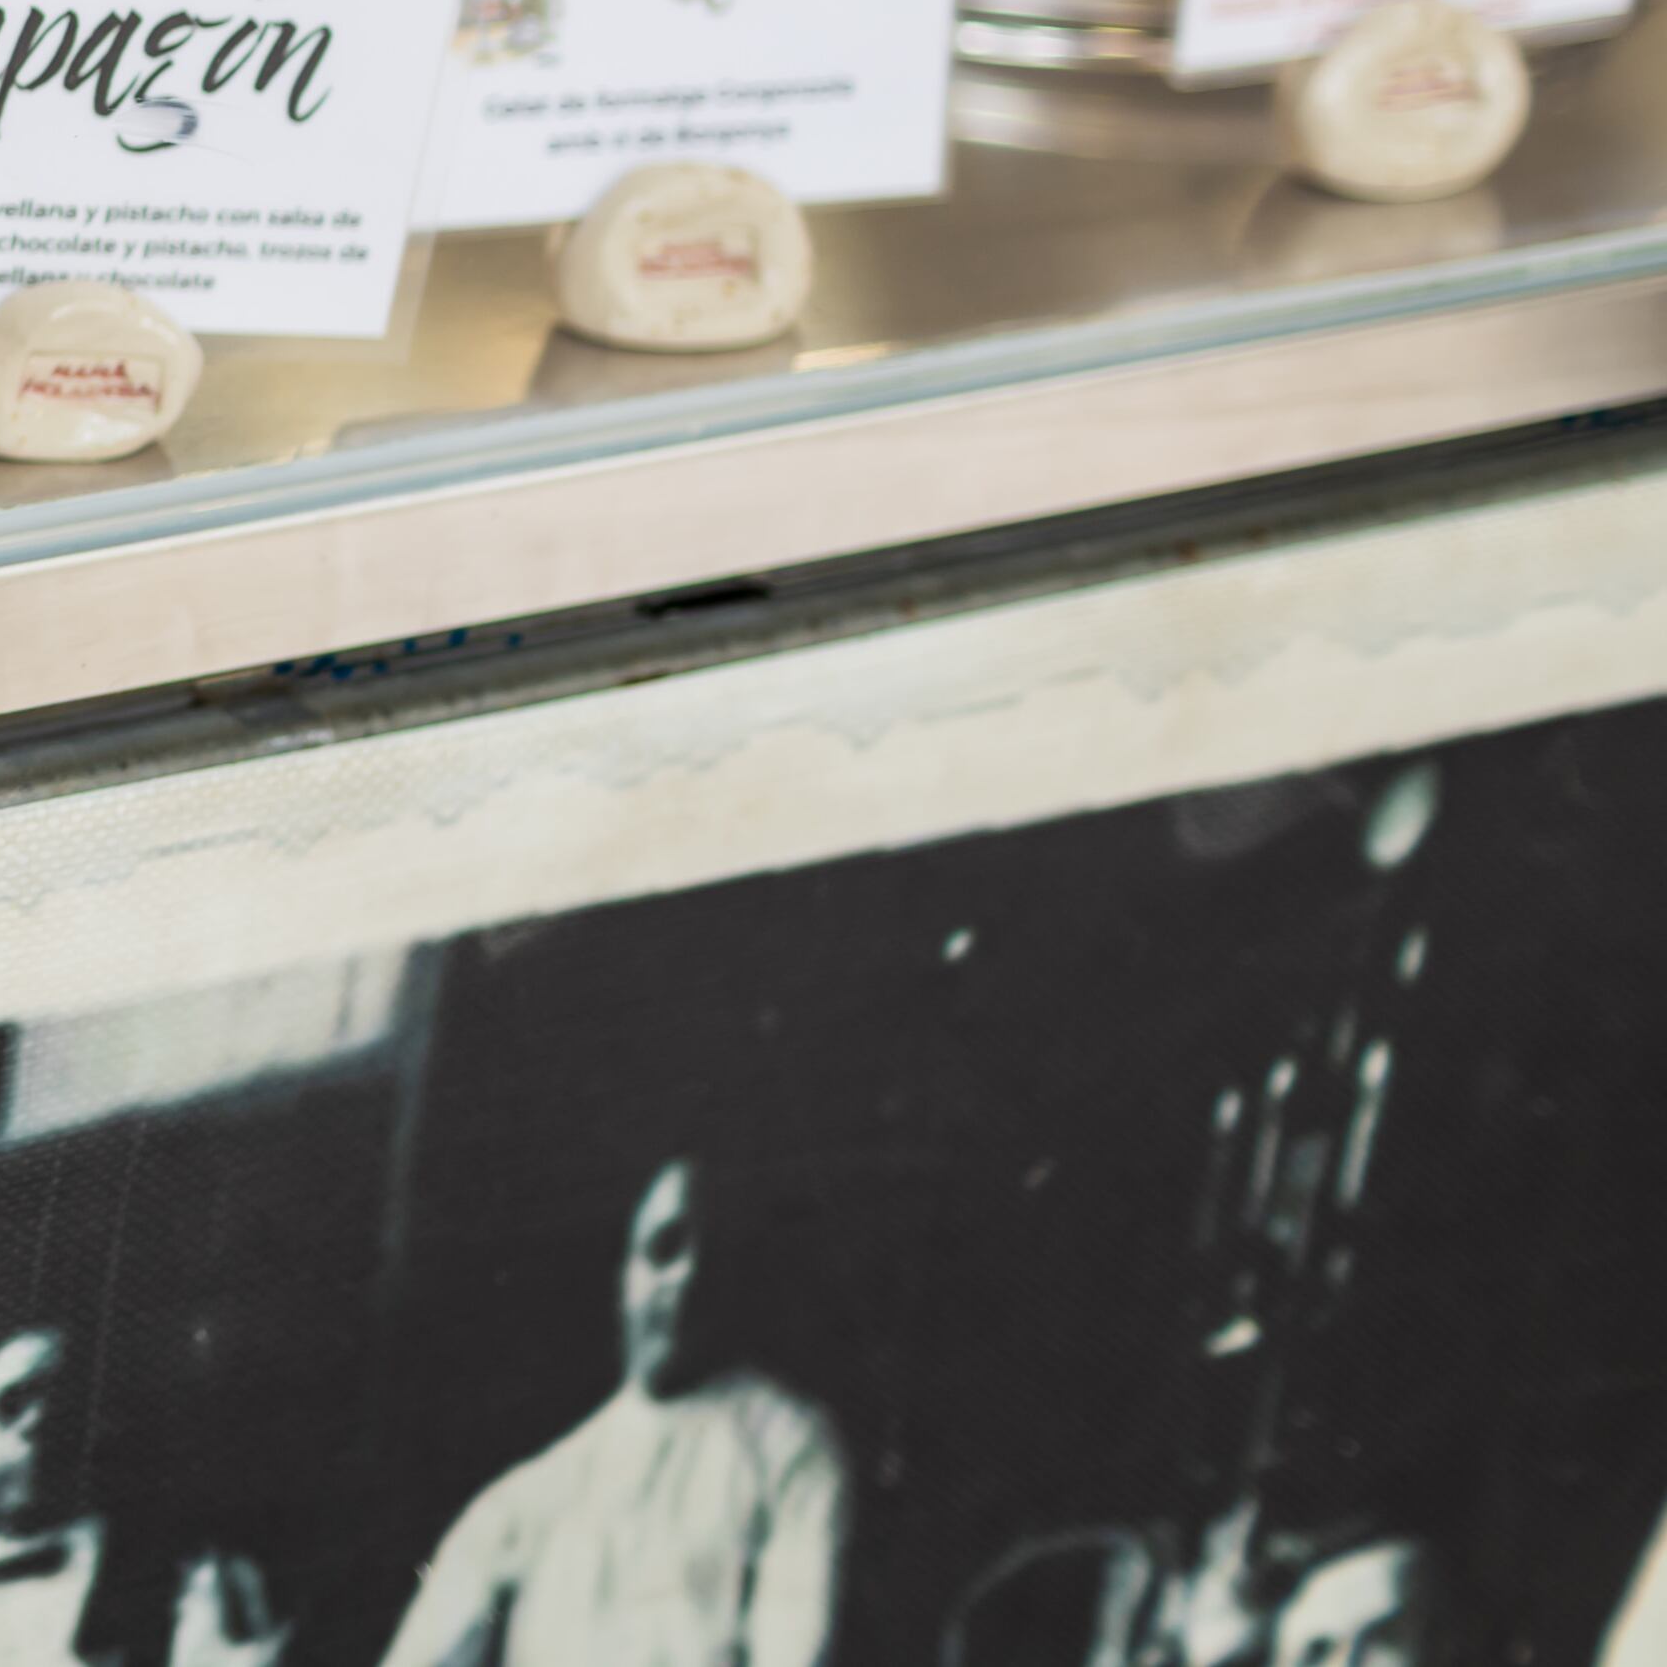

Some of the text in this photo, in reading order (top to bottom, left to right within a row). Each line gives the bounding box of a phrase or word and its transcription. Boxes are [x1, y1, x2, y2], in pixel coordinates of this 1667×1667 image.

[84, 206, 99, 224] y
[104, 203, 209, 225] pistacho
[217, 209, 260, 224] con
[123, 241, 138, 260] y
